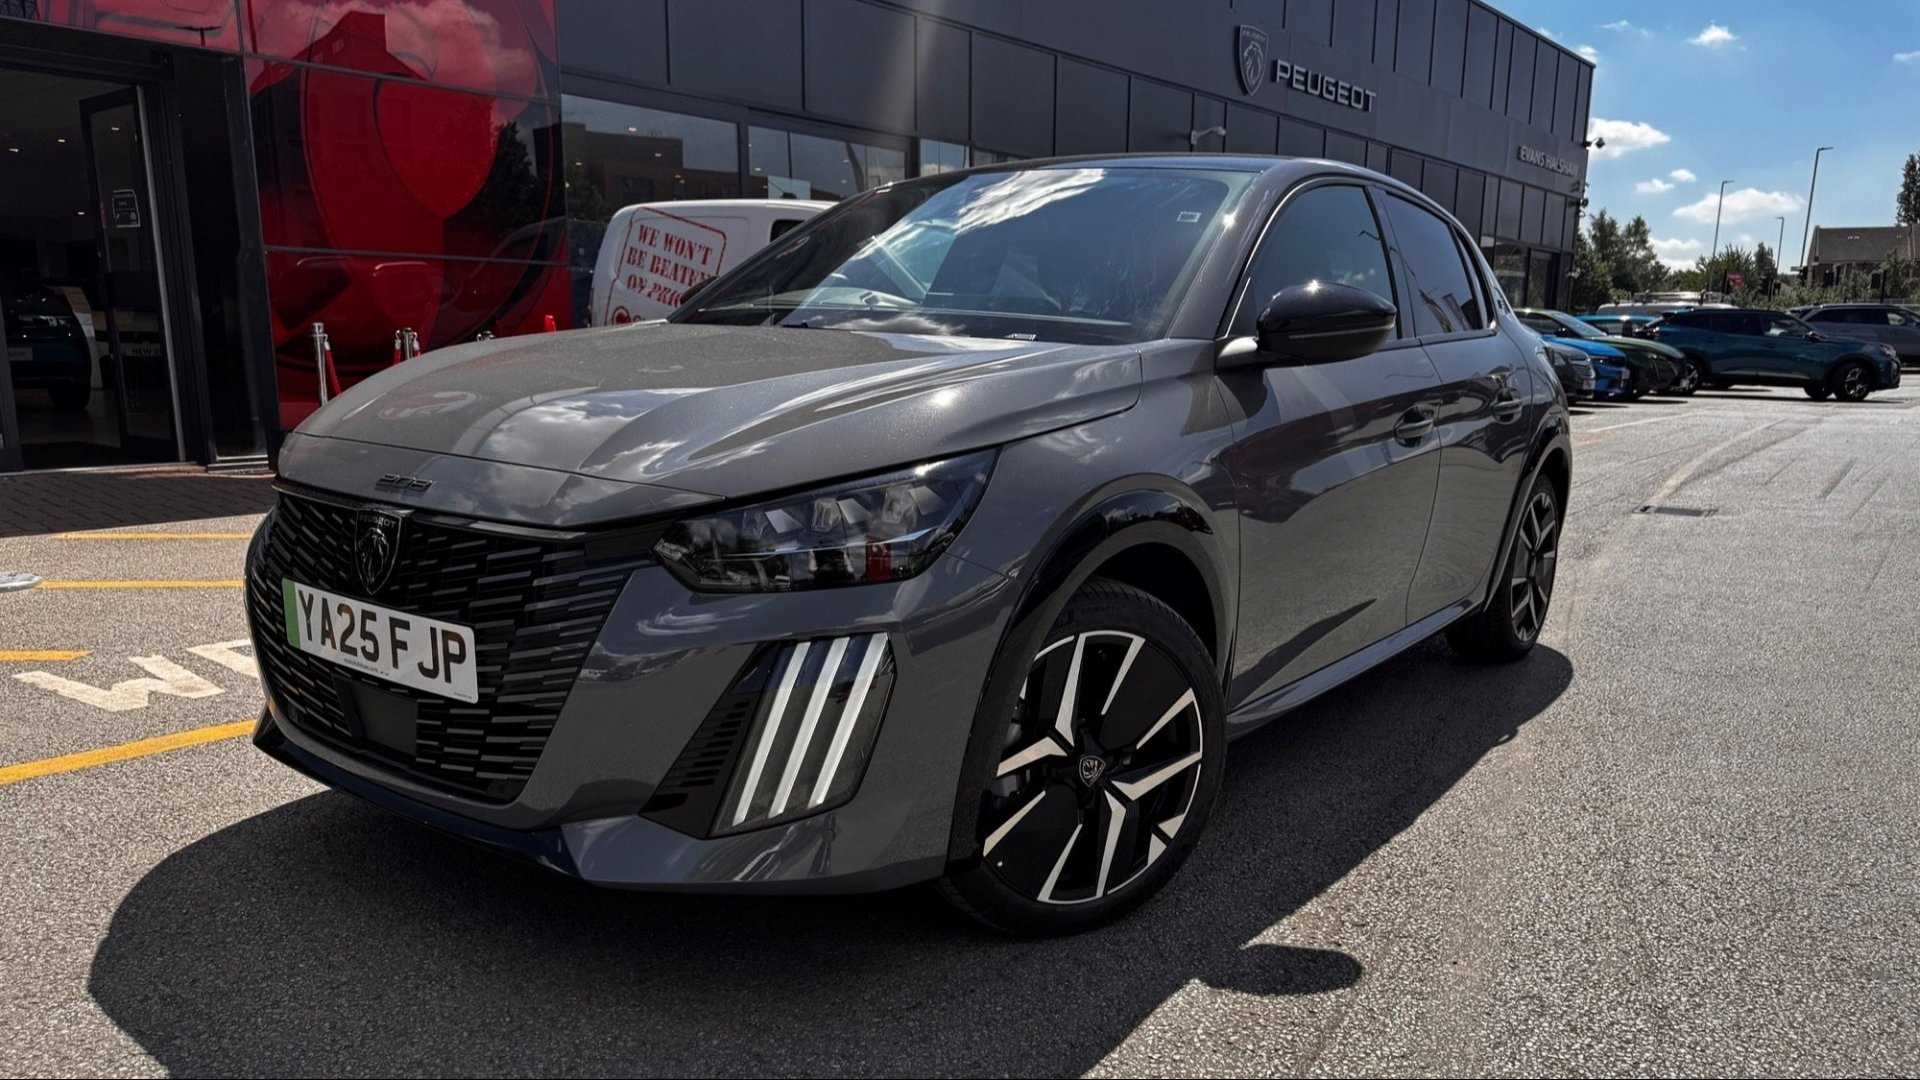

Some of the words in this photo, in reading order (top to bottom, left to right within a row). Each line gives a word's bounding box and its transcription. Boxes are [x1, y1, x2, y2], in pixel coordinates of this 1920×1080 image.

[1276, 59, 1376, 112] PEUGEOT
[1519, 145, 1545, 168] EVANS
[626, 246, 648, 269] BE
[638, 224, 660, 248] WE
[664, 232, 713, 267] WON'T
[626, 274, 647, 294] ON
[298, 589, 380, 663] YA25
